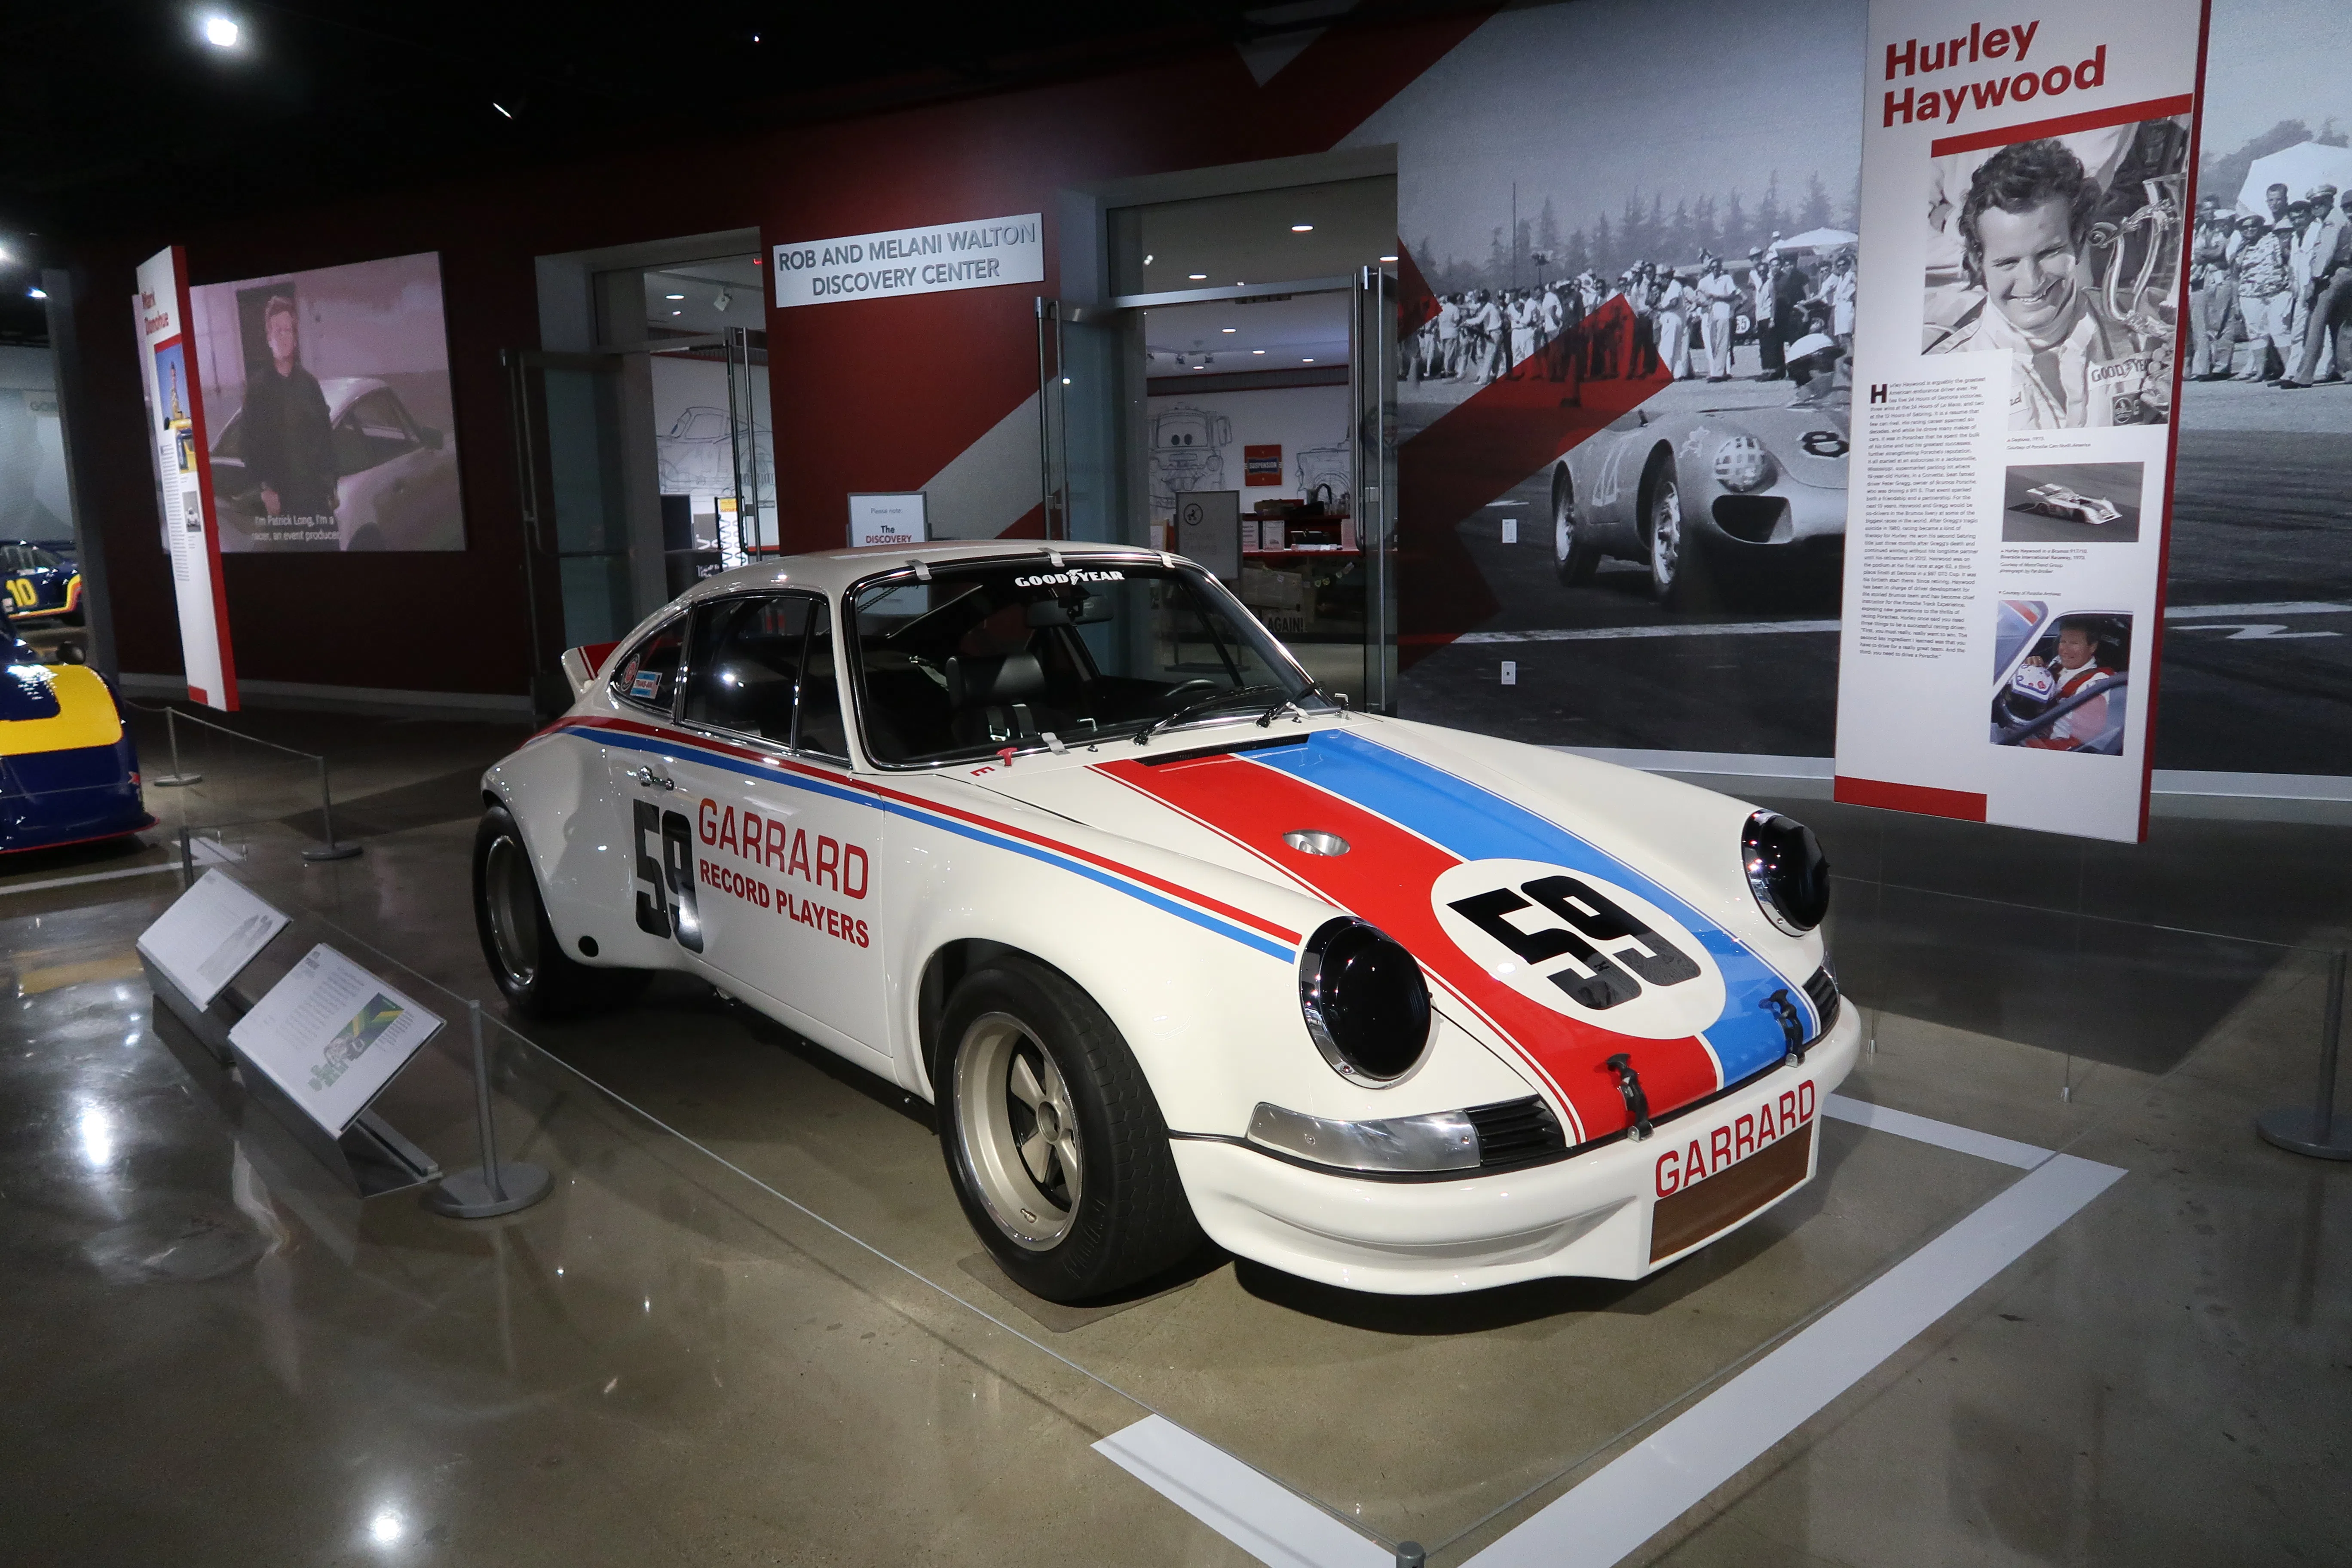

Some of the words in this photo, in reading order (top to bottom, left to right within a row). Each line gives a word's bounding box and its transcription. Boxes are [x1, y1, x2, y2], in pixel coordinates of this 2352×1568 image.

[1885, 20, 2040, 81] Hurley
[1883, 44, 2107, 128] Haywood
[779, 250, 816, 271] ROB
[821, 244, 863, 266] AND
[869, 234, 942, 260] MELANI
[946, 223, 1035, 251] WALTON
[812, 266, 917, 296] DISCOVERY
[922, 258, 999, 284] CENTER
[267, 515, 292, 526] Patrick
[315, 514, 327, 524] I'm
[283, 531, 304, 540] event
[866, 535, 912, 543] DISCOVERY
[881, 525, 895, 533] The
[6, 579, 36, 607] 10
[1015, 571, 1125, 587] GOODYEAR
[1268, 616, 1304, 632] AGAIN!
[970, 766, 995, 776] E
[698, 797, 869, 900] GARRARD
[633, 798, 704, 954] 59
[699, 858, 770, 908] RECORD
[776, 888, 870, 948] PLAYERS
[1446, 875, 1701, 1010] 59
[1656, 1079, 1815, 1198] GARRARD
